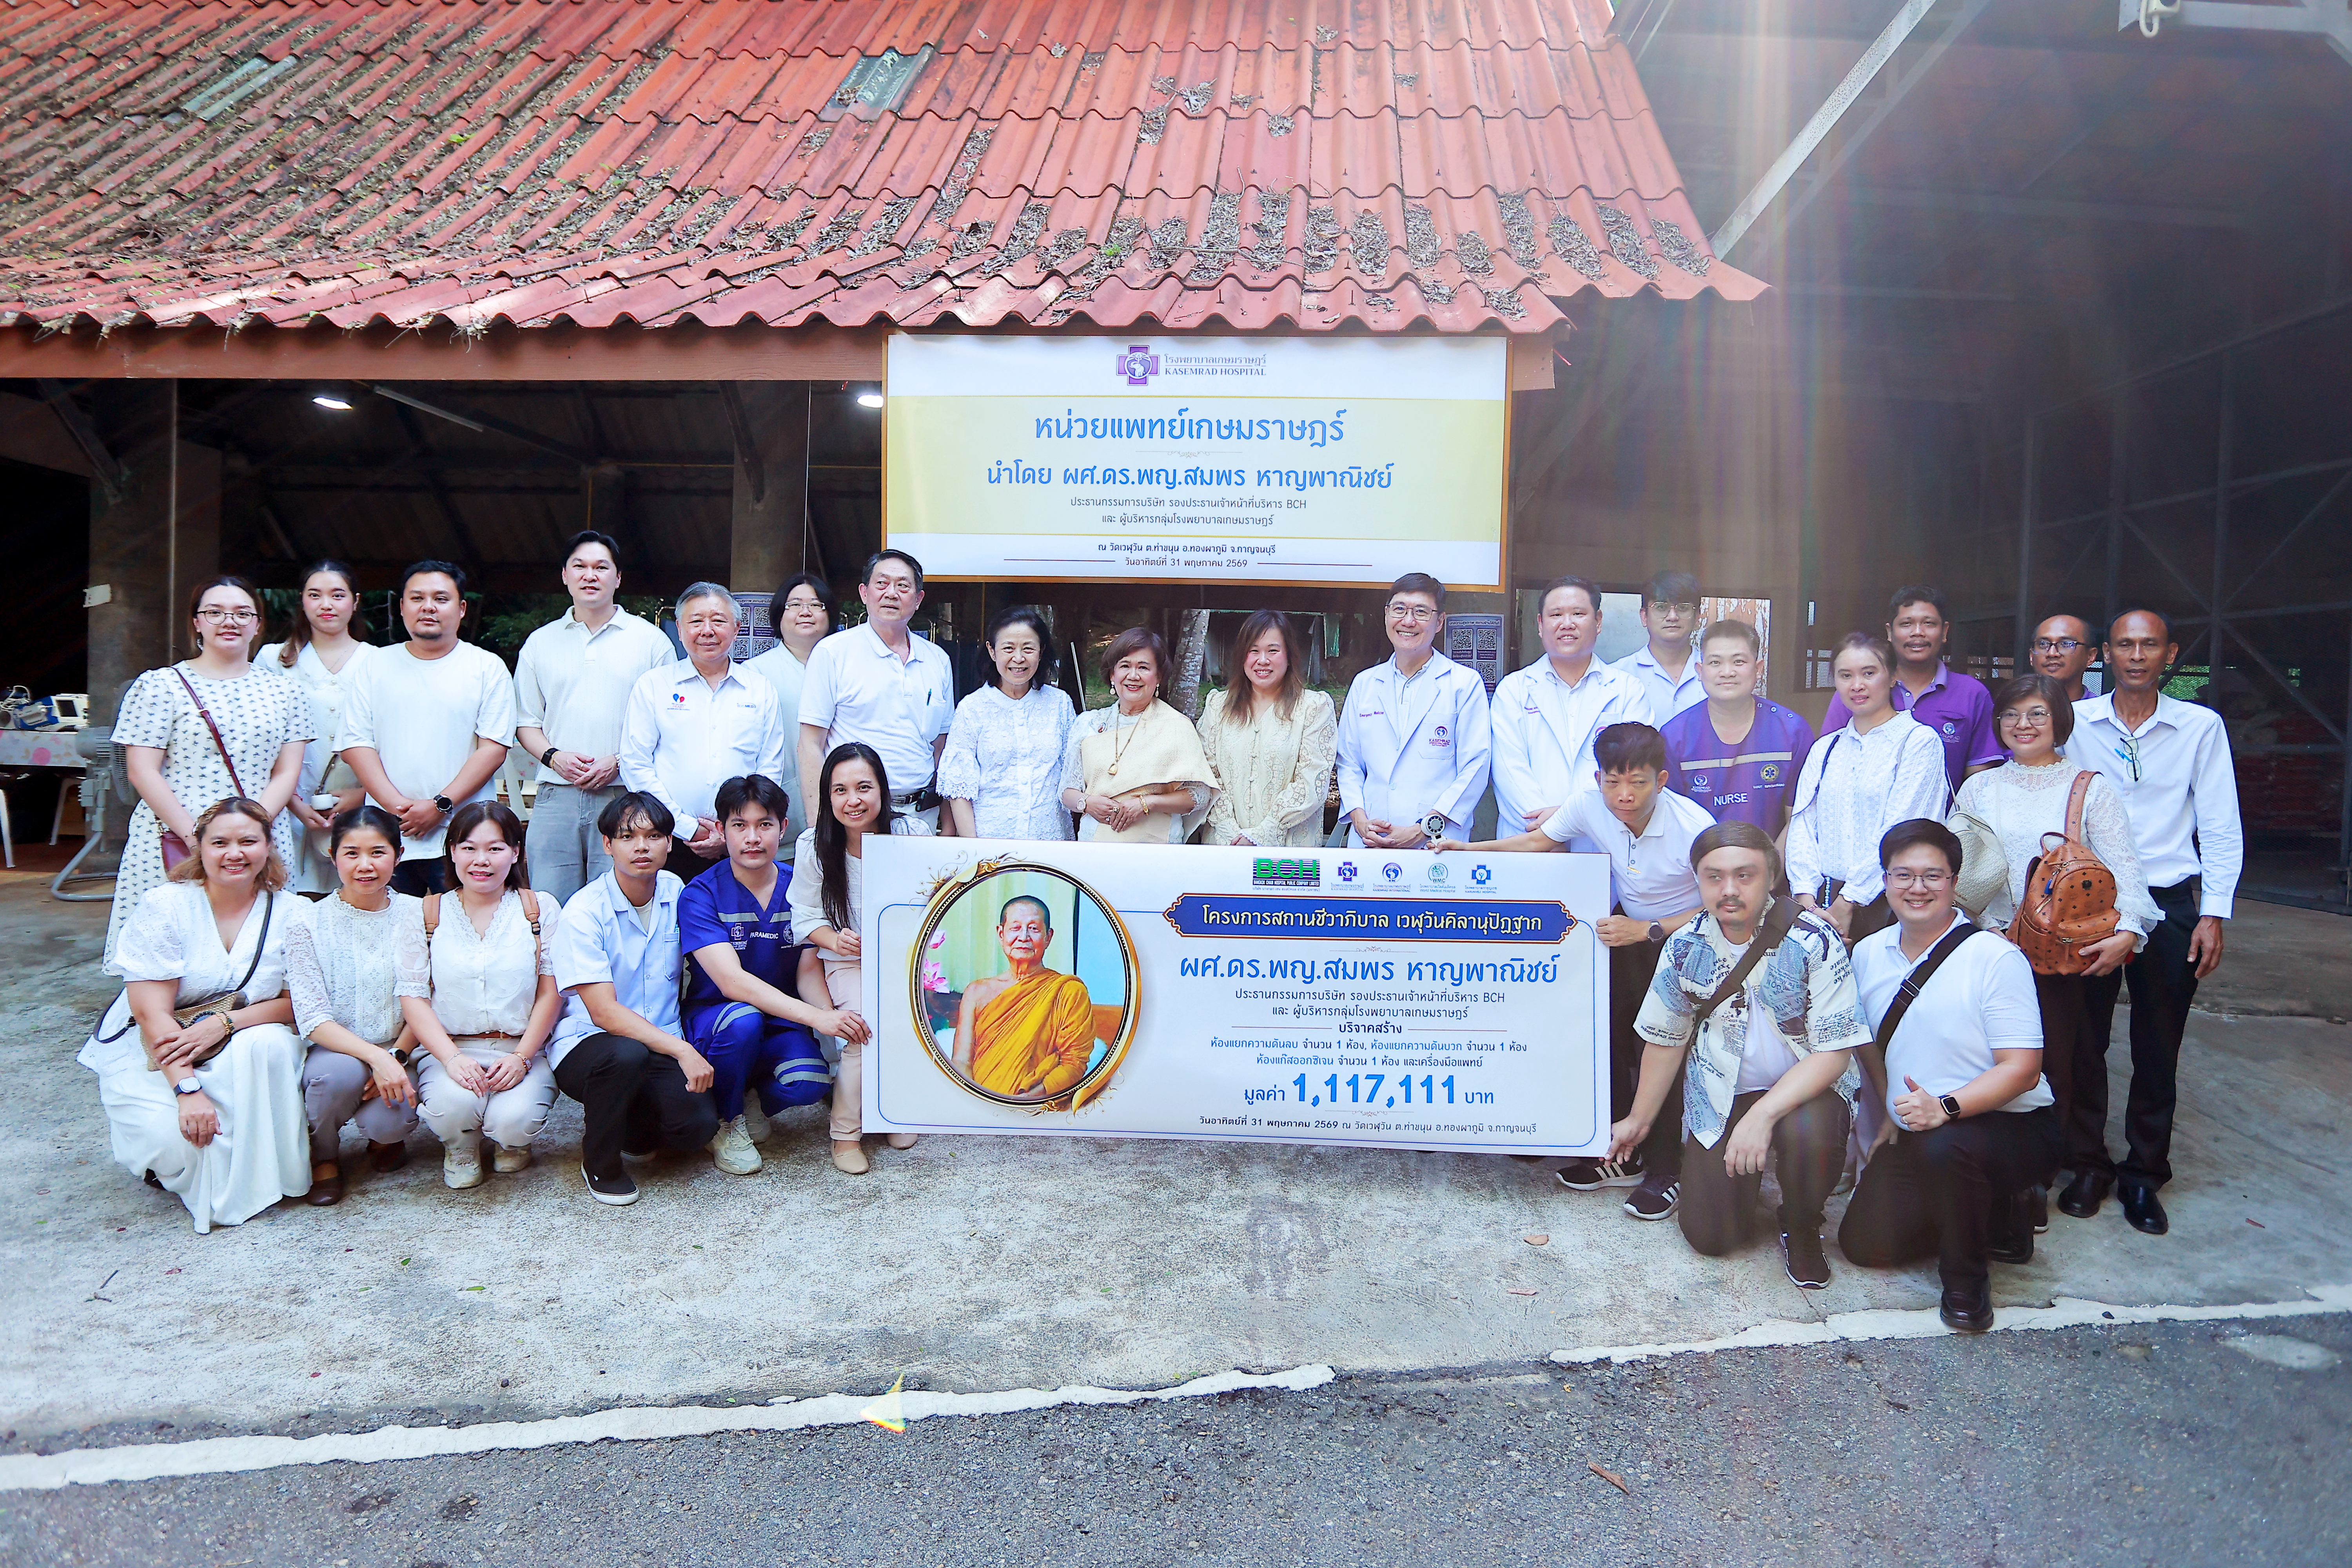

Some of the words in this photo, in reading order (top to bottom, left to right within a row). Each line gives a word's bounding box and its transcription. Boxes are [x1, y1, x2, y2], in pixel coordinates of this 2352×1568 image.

[1165, 354, 1266, 366] โรงพยาบาลเกษมราษฎร์
[1036, 407, 1347, 447] หน่วยแพทย์เกษมราษฎร์
[988, 459, 1051, 484] นำโดย
[1064, 466, 1245, 489] ผศ.ดร.พญ.สมพร
[1257, 463, 1394, 491] หาญพาณิชย์
[1071, 497, 1164, 506] ประธานกรรมการบริษัท
[1170, 495, 1282, 508] รองประธานเจ้าหน้าที่บริหาร
[1287, 500, 1306, 508] BCH
[1120, 513, 1274, 526] ผู้บริหารกลุ่มโรงพยาบาลเกษมราษฎร์
[1110, 543, 1142, 554] วัดเวฬุวัน
[1147, 543, 1179, 554] ต.ท่าขนุน
[1183, 545, 1226, 555] อ.ทองผาภูมิ
[1230, 545, 1275, 555] จ.กาญจนบุรี
[1125, 557, 1166, 566] วันอาทิตย์ที่
[1714, 793, 1748, 806] NURSE
[1256, 858, 1317, 878] BCH
[1202, 904, 1389, 928] โครงการสถานชีวาภิบาล
[1396, 911, 1542, 935] เวฬุวันคิลานุปัฏฐาก
[750, 931, 779, 940] PARAMEDIC
[1181, 955, 1394, 984] ผศ.ดร.พญ.สมพร
[1408, 954, 1560, 986] หาญพาณิชย์
[1236, 988, 1345, 1000] ประธานกรรมการบริษัท
[1351, 988, 1478, 1002] รองประธานเจ้าหน้าที่บริหาร
[1484, 993, 1504, 1002] BCH
[1294, 1004, 1469, 1020] ผู้บริหารกลุ่มโรงพยาบาลเกษมราษฎร์
[1339, 1021, 1401, 1033] บริจาคสร้าง
[1211, 1038, 1298, 1048] ห้องแยกความดันลบ
[1337, 1040, 1341, 1049] 1
[1347, 1038, 1366, 1050] ห้อง,
[1371, 1039, 1461, 1050] ห้องแยกความดันบวก
[1466, 1041, 1495, 1051] จำนวน
[1500, 1042, 1504, 1051] 1
[1510, 1041, 1526, 1051] ห้อง
[1257, 1053, 1333, 1065] ห้องแก๊สออกซิเจน
[1338, 1055, 1367, 1065] จำนวน
[1372, 1056, 1376, 1065] 1
[1382, 1055, 1399, 1065] ห้อง
[1404, 1053, 1483, 1067] และเครื่องมือแพทย์
[1245, 1085, 1285, 1105] มูลค่า
[1293, 1073, 1454, 1108] 1,117,111
[1465, 1093, 1493, 1103] บาท
[1200, 1115, 1247, 1125] วันอาทิตย์ที่
[1355, 1121, 1391, 1132] วัดเวฬุวัน
[1396, 1122, 1431, 1133] ต.ท่าขนุน
[1436, 1123, 1483, 1134] อ.ทองผาภูมิ
[1488, 1123, 1536, 1134] จ.กาญจนบุรี
[1694, 1109, 1703, 1130] MOON
